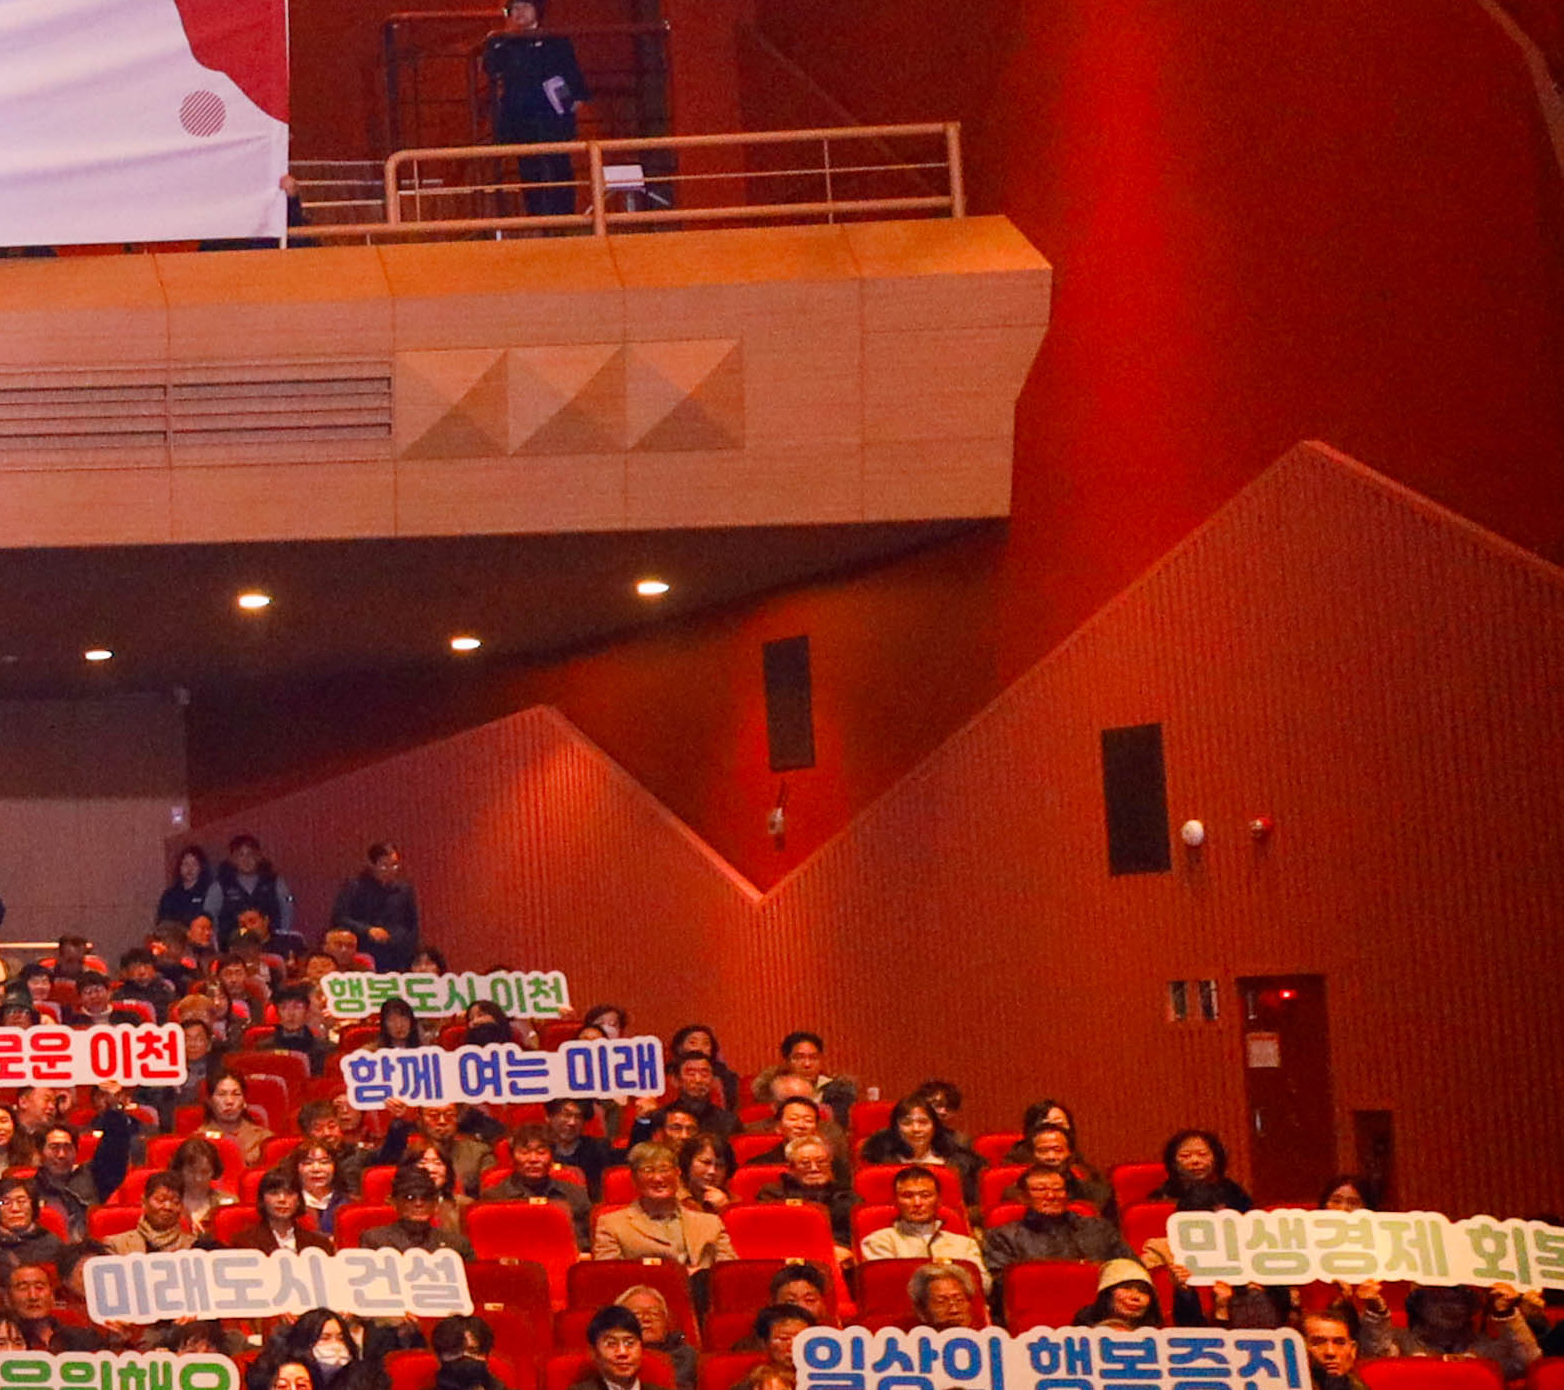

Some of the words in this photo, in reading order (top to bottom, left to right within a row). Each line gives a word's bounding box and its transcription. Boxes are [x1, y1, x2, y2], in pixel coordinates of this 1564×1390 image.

[327, 977, 477, 1013] 행복도시
[490, 975, 562, 1012] 이천
[90, 1025, 182, 1080] 이천
[349, 1052, 443, 1104] 함께
[459, 1049, 550, 1097] 여는
[566, 1043, 659, 1092] 미래
[1176, 1215, 1448, 1283] 민생경제
[90, 1254, 330, 1317] 미래도시
[344, 1255, 465, 1309] 건설
